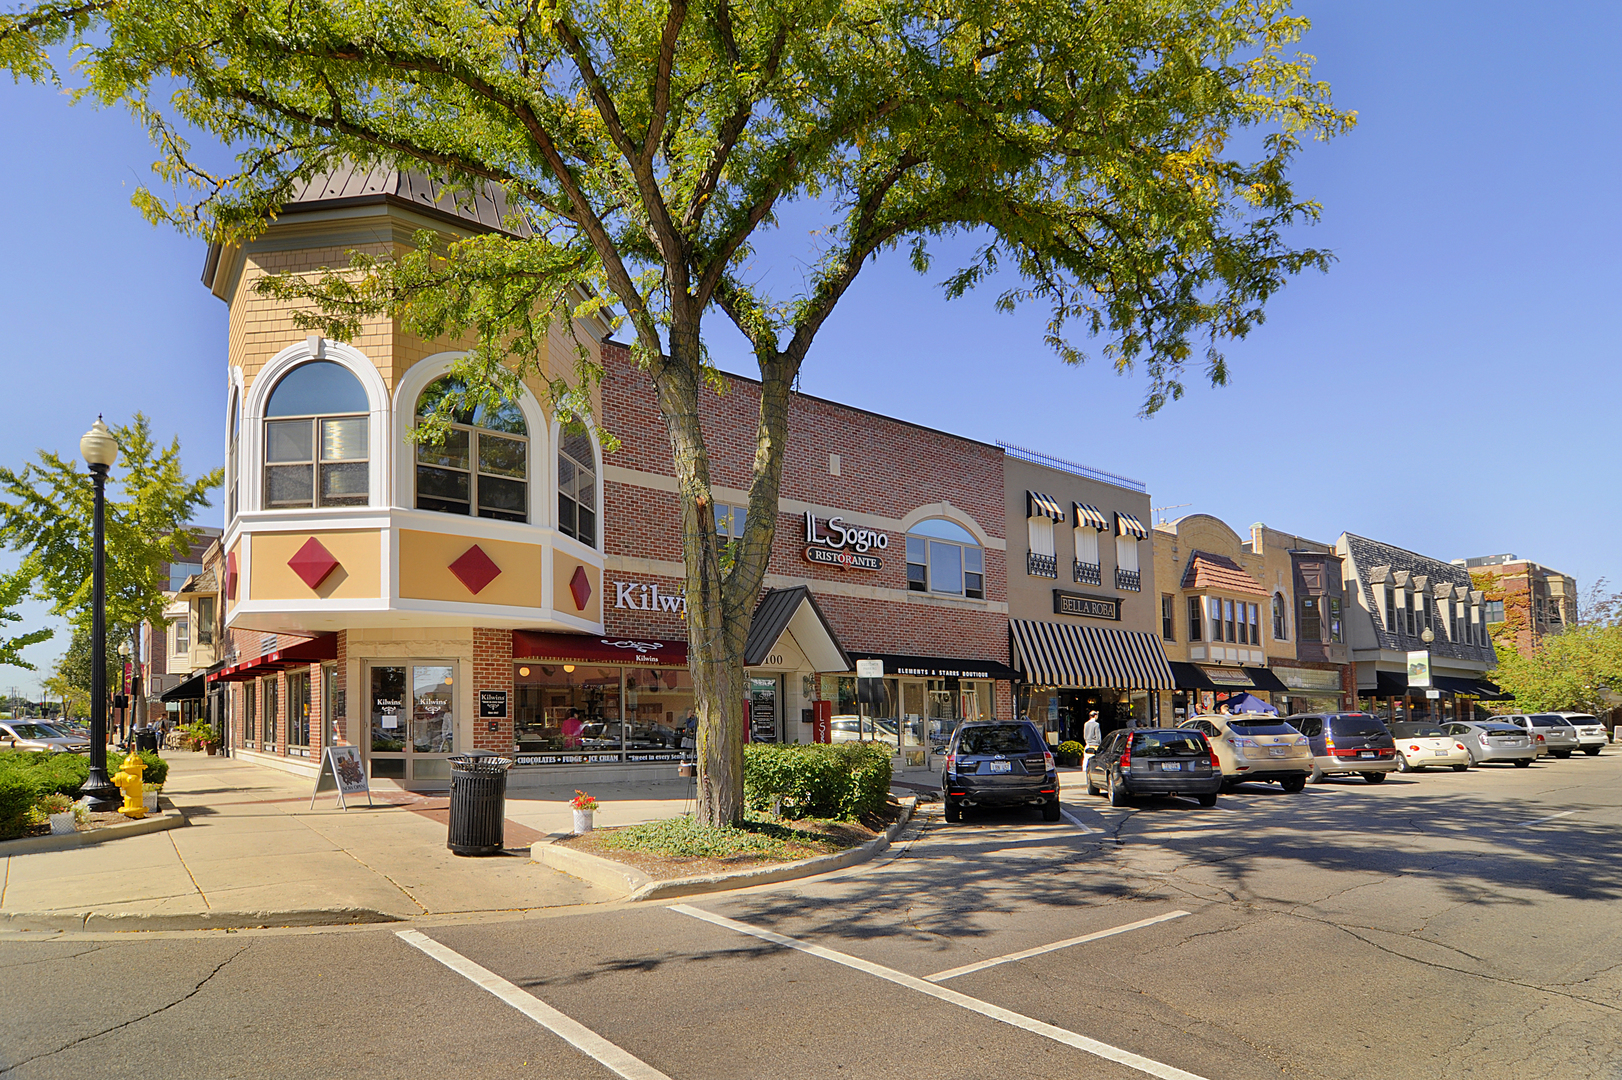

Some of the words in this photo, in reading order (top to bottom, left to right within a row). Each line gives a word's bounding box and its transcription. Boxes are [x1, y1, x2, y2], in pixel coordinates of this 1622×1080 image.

[806, 510, 826, 544] IL
[826, 516, 888, 553] Sogno
[815, 550, 877, 568] RISTORANTE
[613, 581, 687, 614] Kilwi
[1062, 598, 1090, 613] BELLA
[1091, 602, 1114, 616] ROBA
[635, 654, 659, 662] Kilwins
[765, 654, 783, 665] 100
[897, 667, 929, 675] ELEMENTS
[961, 670, 989, 678] BOUTIQUE
[377, 698, 402, 706] Kilwins
[481, 693, 505, 701] Kilwins
[517, 756, 556, 764] CHOCOLATES
[599, 754, 619, 762] CREAM
